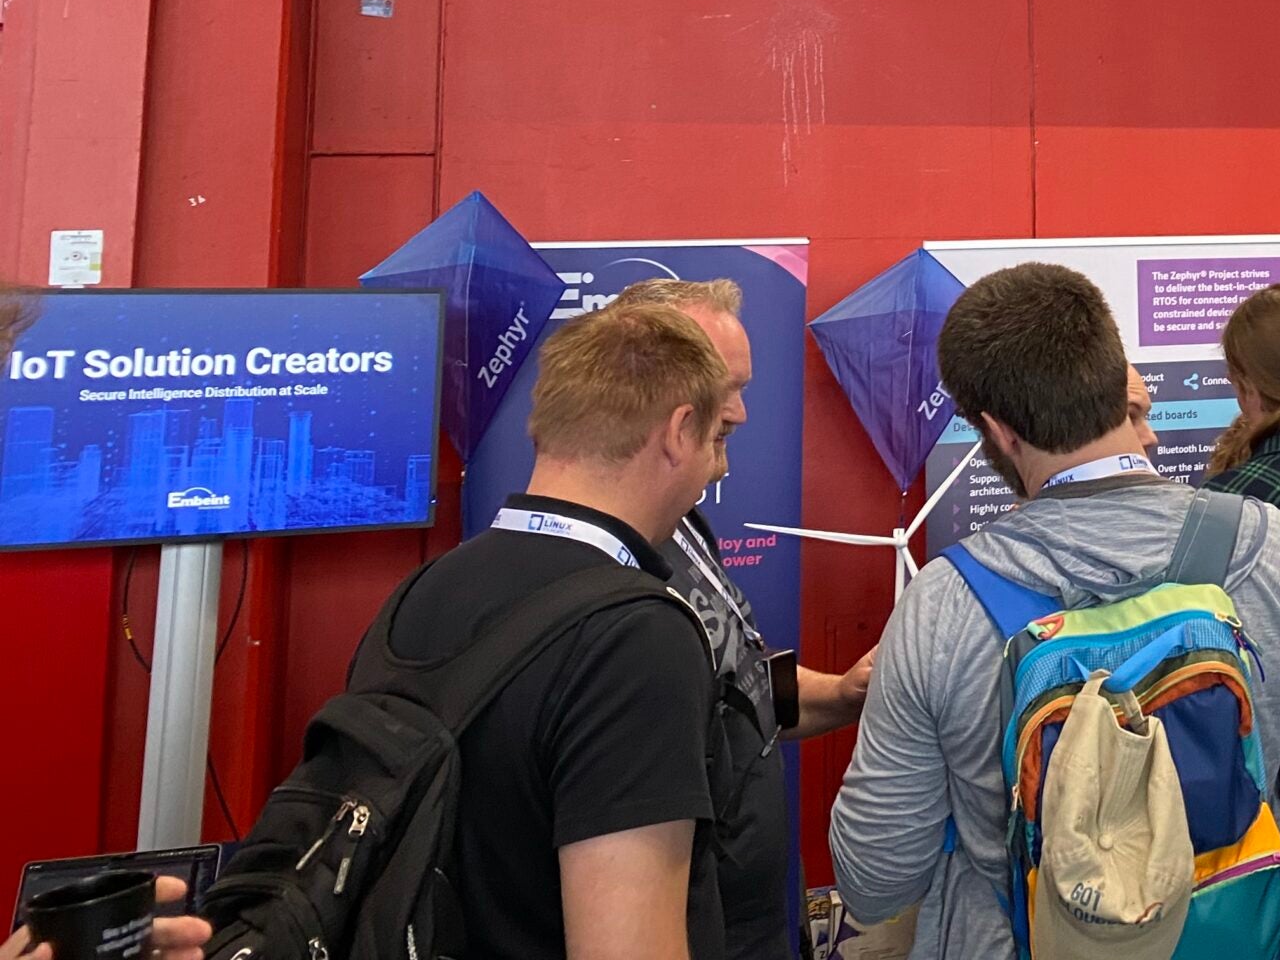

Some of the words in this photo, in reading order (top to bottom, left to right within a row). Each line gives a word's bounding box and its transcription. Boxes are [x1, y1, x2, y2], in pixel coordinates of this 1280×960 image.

[1152, 271, 1168, 281] The
[1208, 270, 1239, 281] Project
[1240, 269, 1270, 279] strives
[1154, 285, 1165, 293] to
[1166, 283, 1196, 293] deliver
[1197, 283, 1213, 292] the
[1153, 297, 1177, 306] RTOS
[1178, 296, 1192, 305] for
[1193, 295, 1238, 305] connected
[1153, 308, 1205, 319] constrained
[1153, 322, 1165, 332] be
[1166, 323, 1196, 331] secure
[1197, 321, 1214, 330] and
[10, 349, 75, 380] IoT
[83, 347, 237, 379] Solution
[245, 347, 394, 375] Creators
[79, 387, 126, 403] Secure
[128, 386, 203, 402] Intelligence
[204, 385, 277, 399] Distribution
[278, 386, 292, 398] at
[293, 384, 329, 397] Scale
[1165, 410, 1198, 420] boards
[1157, 444, 1197, 455] Bluetooth
[1157, 464, 1177, 473] Over
[1178, 462, 1193, 471] the
[1194, 462, 1206, 471] air
[166, 489, 231, 508] Embeint
[970, 503, 999, 515] Highly
[745, 534, 777, 549] and
[722, 554, 763, 567] ower
[1070, 882, 1103, 912] GOT
